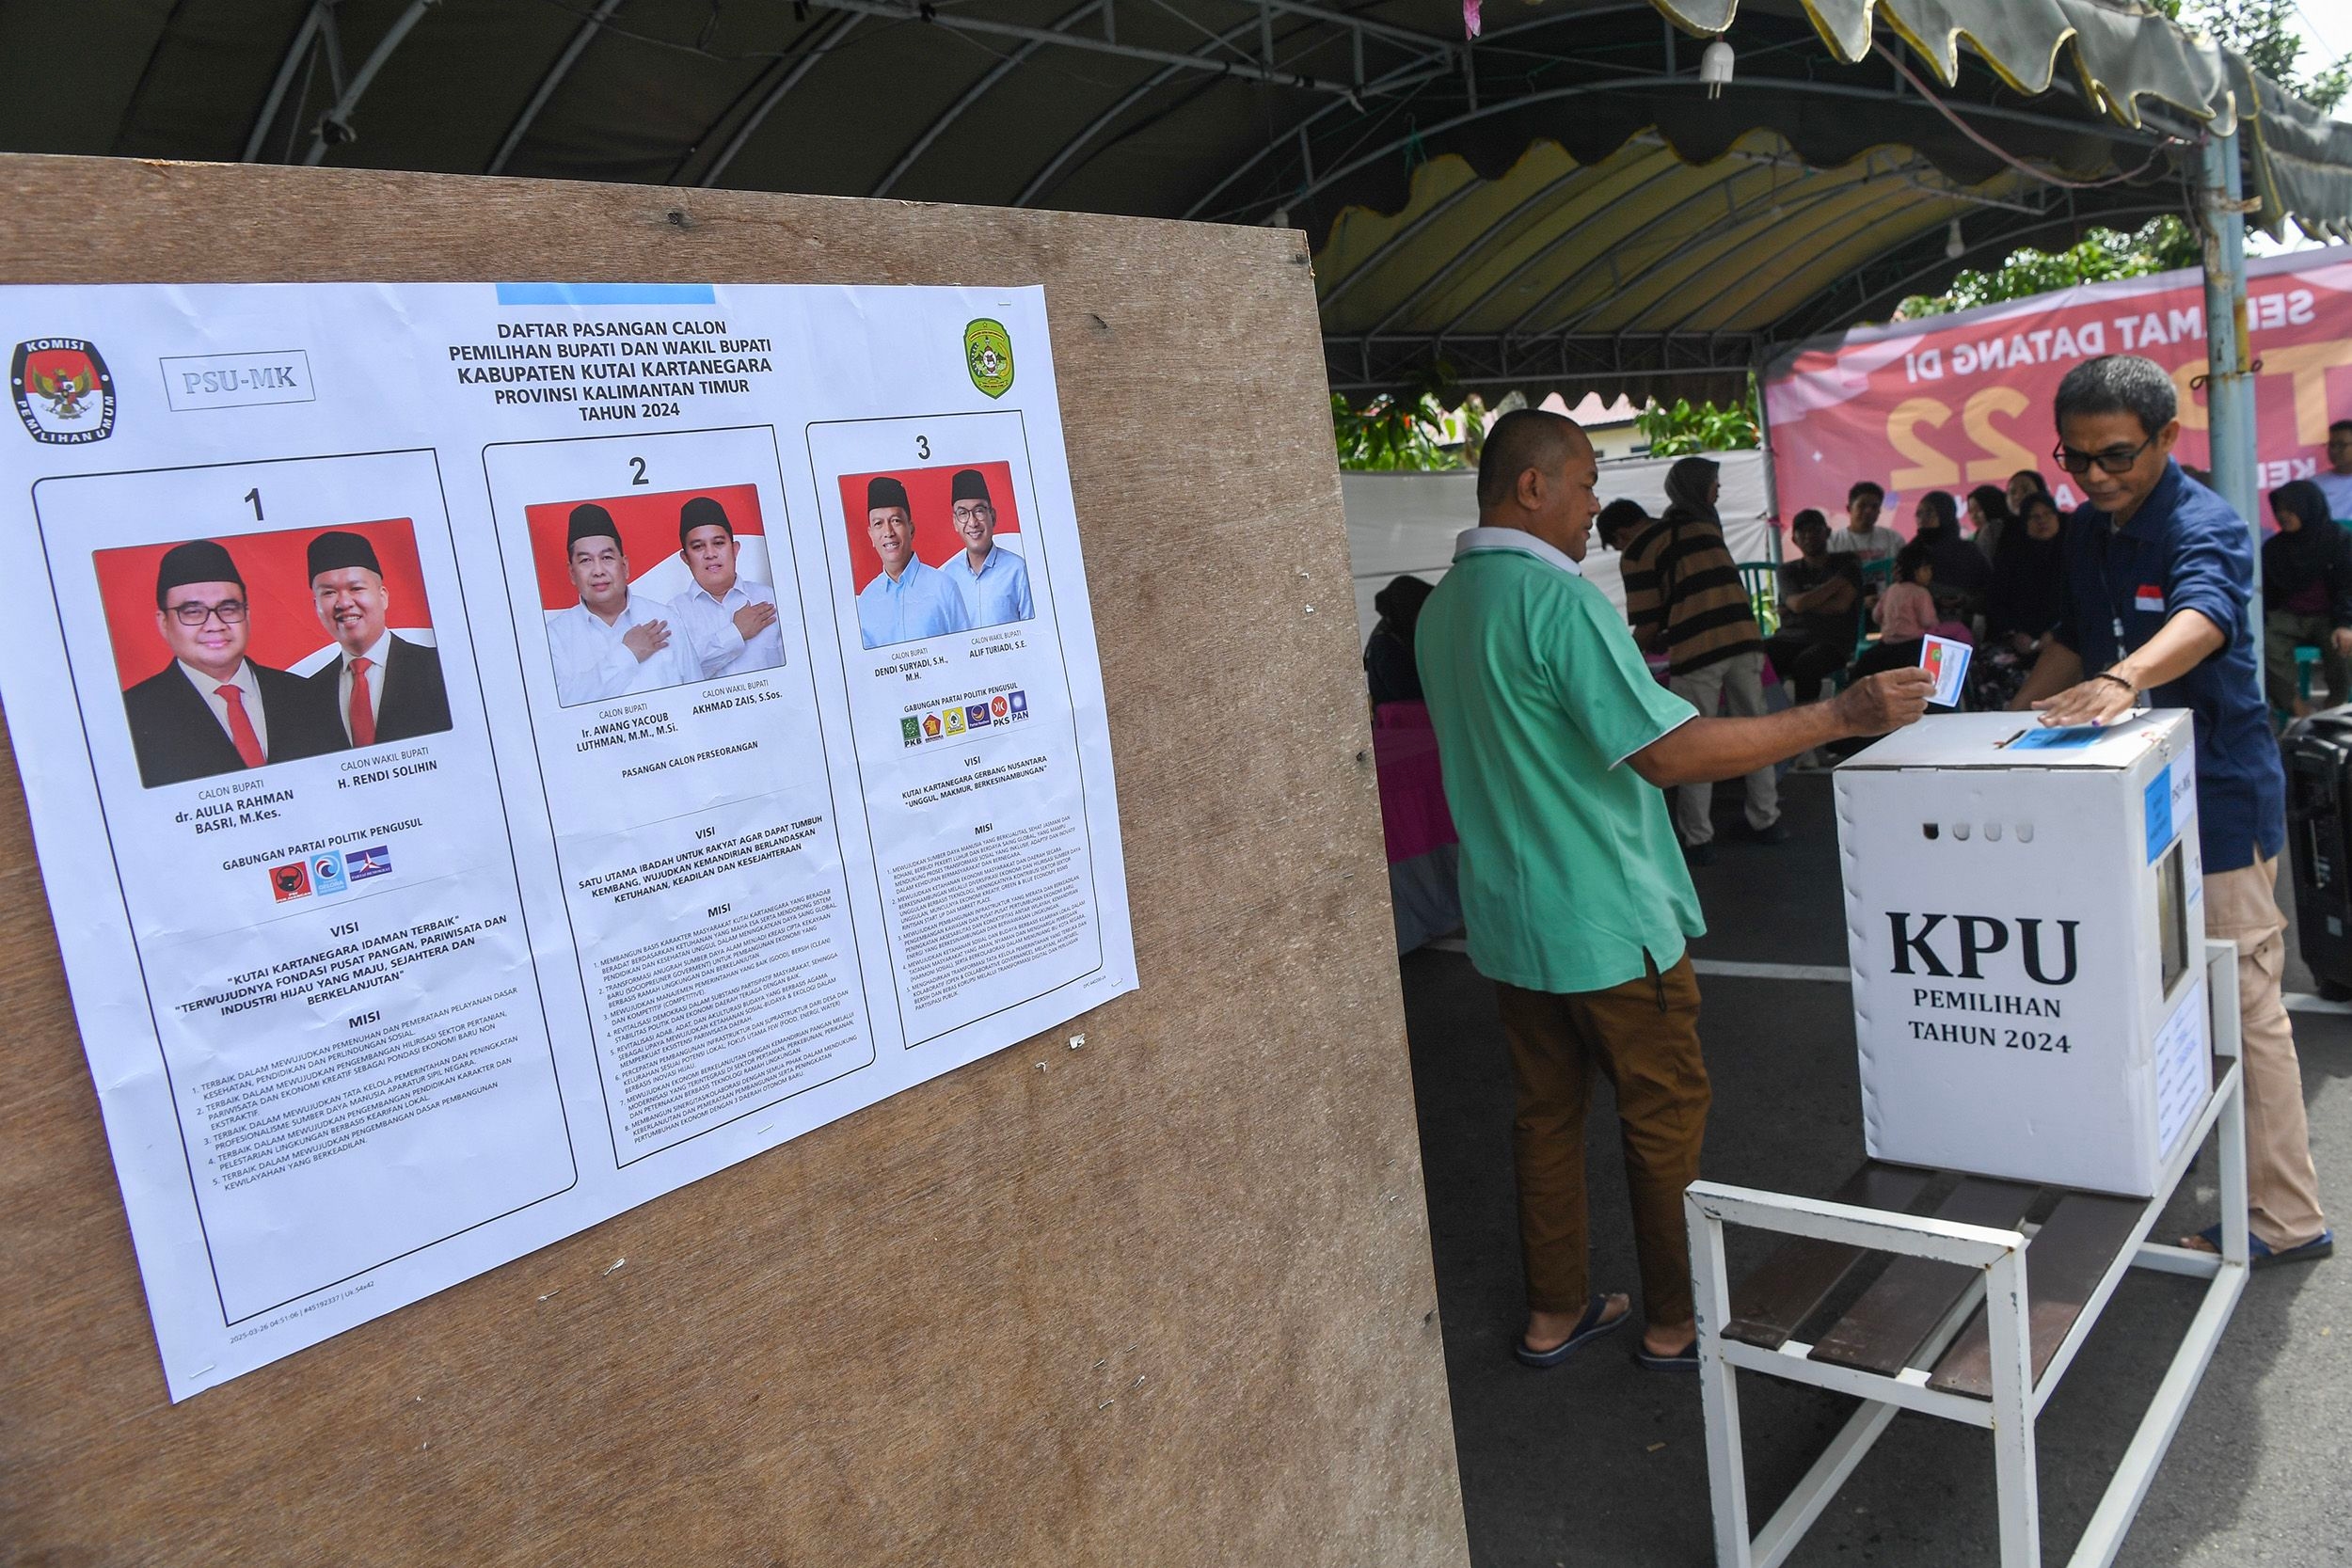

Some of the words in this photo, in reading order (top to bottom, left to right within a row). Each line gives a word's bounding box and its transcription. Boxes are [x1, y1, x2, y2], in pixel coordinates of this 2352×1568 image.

[497, 323, 569, 339] DAFTAR
[572, 322, 668, 338] PASANGAN
[672, 321, 727, 336] CALON
[25, 340, 85, 352] KOMISI
[449, 343, 552, 361] PEMILIHAN
[556, 342, 616, 358] BUPATI
[620, 341, 659, 356] DAN
[661, 340, 717, 356] WAKIL
[719, 339, 771, 354] BUPATI
[182, 366, 297, 394] PSU-MK
[457, 364, 576, 385] KABUPATEN
[580, 362, 636, 380] KUTAI
[641, 357, 773, 377] KARTANEGARA
[494, 387, 578, 404] PROVINSI
[582, 381, 695, 401] KALIMANTAN
[698, 379, 750, 395] TIMUR
[17, 400, 92, 443] PEMILIHAN
[96, 395, 114, 438] UMUM
[578, 404, 637, 421] TAHUN
[641, 402, 681, 418] 2024
[915, 435, 931, 460] 3
[628, 456, 650, 486] 2
[244, 487, 264, 522] 1
[970, 634, 989, 646] CALON
[988, 632, 1005, 642] WAKIL
[1003, 629, 1022, 640] BUPATI
[890, 649, 911, 662] CALON
[909, 647, 929, 657] BUPATI
[969, 647, 985, 658] ALIF
[874, 664, 898, 677] DENDI
[702, 686, 725, 699] CALON
[724, 684, 747, 695] WAKIL
[746, 678, 770, 690] BUPATI
[903, 698, 941, 713] GABUNGAN
[941, 693, 963, 705] PARTAI
[962, 688, 988, 701] POLITIK
[987, 682, 1019, 695] PENGUSUL
[597, 707, 624, 720] CALON
[624, 703, 648, 715] BUPATI
[692, 699, 734, 716] AKHMAD
[734, 694, 757, 707] ZAIS,
[758, 690, 783, 703] S.Sos.
[1011, 711, 1029, 721] PAN
[581, 729, 593, 738] Ir.
[593, 720, 630, 736] AWANG
[630, 712, 669, 728] YACOUB
[993, 716, 1010, 727] PKS
[576, 734, 627, 752] LUTHMAN,
[628, 728, 655, 742] M.M.,
[655, 721, 678, 736] M.Si.
[904, 737, 922, 748] PKB
[340, 757, 372, 772] CALON
[371, 752, 401, 766] WAKIL
[400, 746, 429, 760] BUPATI
[621, 760, 667, 779] PASANGAN
[668, 754, 696, 768] CALON
[696, 740, 758, 762] PERSEORANGAN
[963, 755, 981, 768] VISI
[337, 778, 351, 790] H.
[352, 769, 390, 786] RENDI
[391, 759, 437, 779] SOLIHIN
[901, 787, 922, 800] KUTAI
[922, 774, 974, 794] KARTANEGARA
[974, 765, 1007, 780] GERBANG
[1007, 755, 1048, 771] NUSANTARA
[198, 785, 230, 800] CALON
[231, 779, 264, 794] BUPATI
[174, 811, 193, 824] dr.
[195, 801, 234, 820] AULIA
[236, 789, 294, 811] RAHMAN
[195, 816, 237, 835] BASRI,
[239, 809, 281, 825] M.Kes.
[694, 826, 716, 840] VISI
[974, 822, 993, 835] MISI
[222, 847, 286, 871] GABUNGAN
[287, 838, 326, 856] PARTAI
[327, 829, 369, 847] POLITIK
[369, 817, 423, 837] PENGUSUL
[578, 876, 603, 890] SATU
[604, 866, 638, 882] UTAMA
[639, 856, 675, 873] IBADAH
[675, 847, 705, 863] UNTUK
[705, 838, 738, 854] RAKYAT
[739, 832, 764, 846] AGAR
[764, 824, 789, 838] DAPAT
[789, 815, 823, 831] TUMBUH
[591, 878, 642, 898] KEMBANG,
[642, 863, 692, 883] WUJUDKAN
[692, 846, 754, 869] KEMANDIRIAN
[754, 827, 816, 852] BERLANDASKAN
[613, 880, 671, 904] KETUHANAN,
[672, 867, 716, 887] KEADILAN
[716, 861, 736, 874] DAN
[737, 842, 803, 868] KESEJAHTERAAN
[707, 902, 731, 918] MISI
[329, 921, 359, 938] VISI
[227, 967, 270, 986] "KUTAI
[272, 943, 359, 974] KARTANEGARA
[361, 929, 409, 950] IDAMAN
[409, 914, 460, 936] TERBAIK"
[1885, 911, 2080, 985] KPU
[174, 981, 274, 1013] "TERWUJUDNYA
[275, 965, 327, 988] FONDASI
[329, 954, 365, 973] PUSAT
[367, 941, 418, 961] PANGAN,
[420, 922, 483, 947] PARIWISATA
[484, 914, 507, 928] DAN
[220, 992, 278, 1017] INDUSTRI
[279, 982, 314, 1000] HIJAU
[316, 972, 350, 989] YANG
[352, 962, 388, 979] MAJU,
[389, 944, 450, 969] SEJAHTERA
[451, 936, 475, 951] DAN
[307, 970, 405, 1006] BERKELANJUTAN"
[1913, 989, 2061, 1018] PEMILIHAN
[348, 1009, 381, 1029] MISI
[200, 1074, 236, 1091] TERBAIK
[237, 1064, 270, 1081] DALAM
[270, 1045, 331, 1070] MEWUJUDKAN
[331, 1029, 382, 1052] PEMENUHAN
[382, 1023, 400, 1036] DAN
[400, 1007, 450, 1030] PEMERATAAN
[450, 994, 493, 1013] PELAYANAN
[493, 987, 518, 1002] DASAR
[1908, 1021, 1996, 1046] TAHUN
[2005, 1030, 2072, 1053] 2024
[255, 1063, 307, 1085] PENDIDIKAN
[307, 1056, 326, 1069] DAN
[326, 1035, 388, 1063] PERLINDUNGAN
[224, 1164, 286, 1192] KEWILAYAHAN
[287, 1156, 311, 1170] YANG
